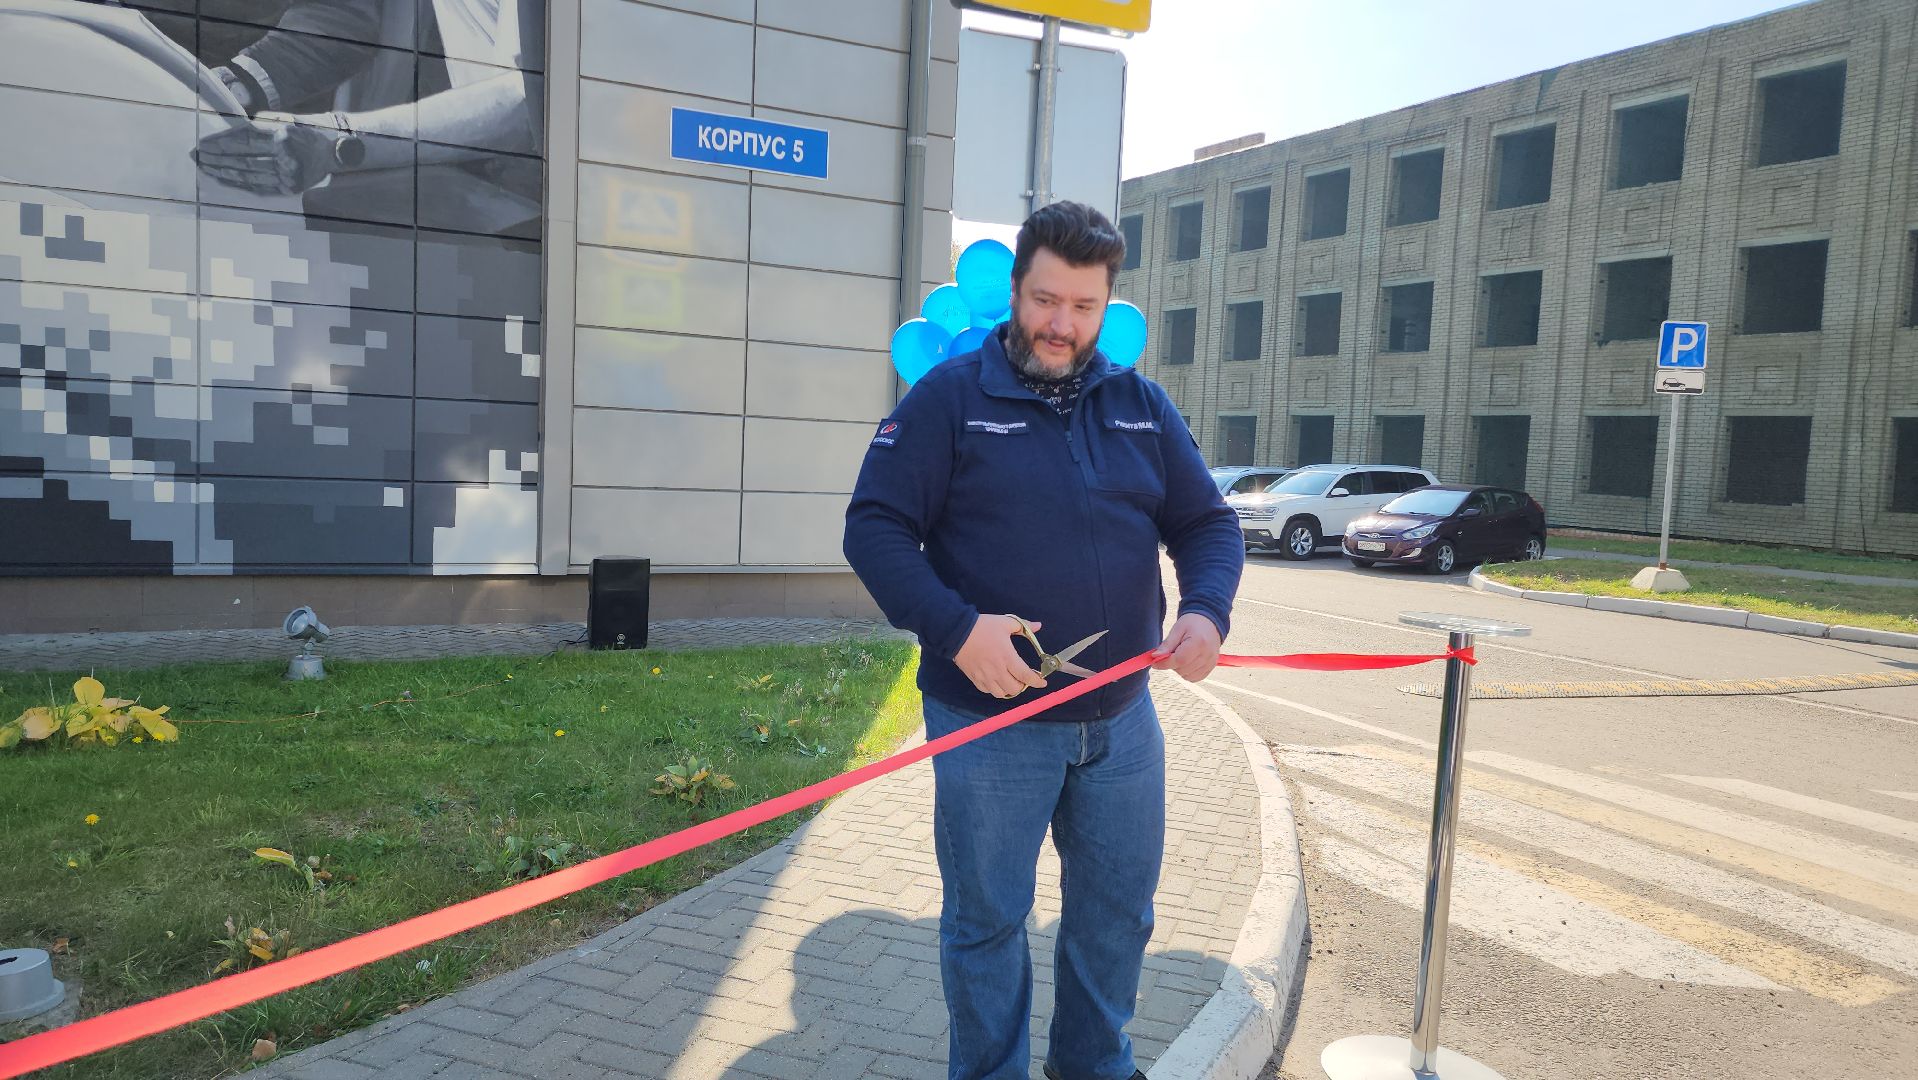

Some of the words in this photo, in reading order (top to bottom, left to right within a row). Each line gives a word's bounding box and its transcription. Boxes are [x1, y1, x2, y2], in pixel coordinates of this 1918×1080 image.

[698, 125, 786, 160] КОРПУС
[792, 140, 804, 163] 5
[1671, 327, 1699, 363] P
